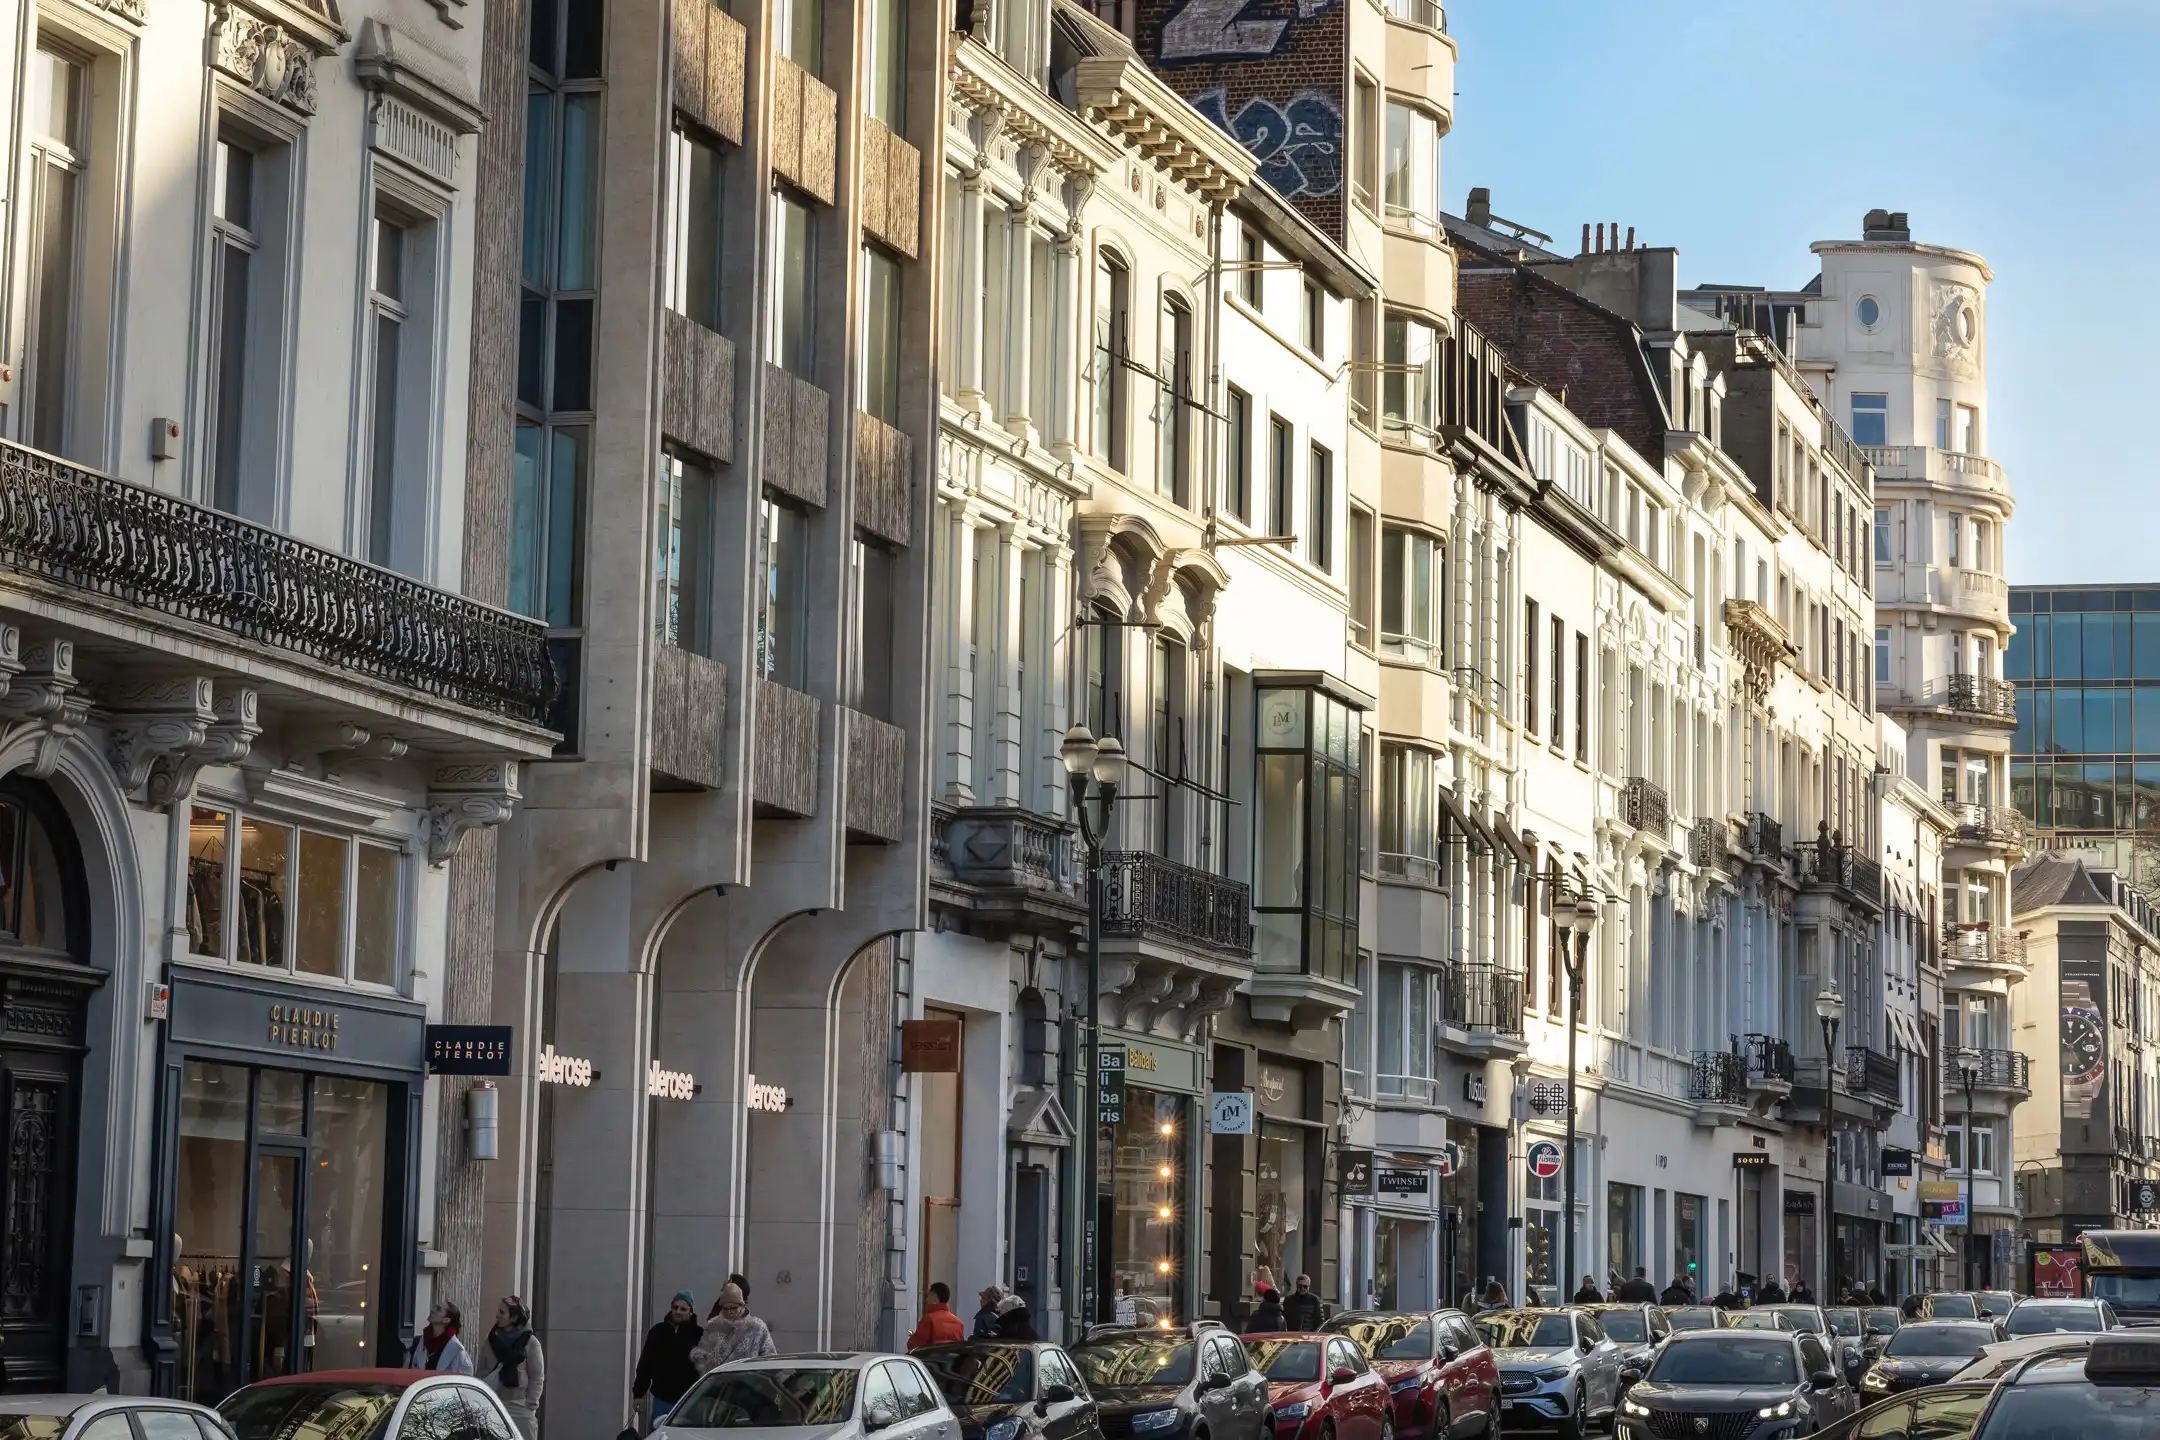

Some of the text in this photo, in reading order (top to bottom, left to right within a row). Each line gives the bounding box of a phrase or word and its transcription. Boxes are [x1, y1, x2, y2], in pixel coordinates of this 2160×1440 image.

[272, 1004, 339, 1029] CLAUDIE
[270, 1025, 338, 1049] PIERLOT
[434, 1041, 505, 1050] CLAUDIE
[434, 1051, 504, 1060] PIERLOT
[1100, 1053, 1120, 1068] Ba
[1128, 1047, 1157, 1071] Balibaris
[540, 1044, 591, 1087] ellerose
[1100, 1072, 1109, 1086] li
[1100, 1090, 1119, 1104] ba
[1100, 1108, 1120, 1122] ris
[1221, 1105, 1241, 1121] LM
[1737, 1156, 1765, 1164] soeur
[1381, 1177, 1424, 1186] TWINSET
[775, 1270, 791, 1284] 66
